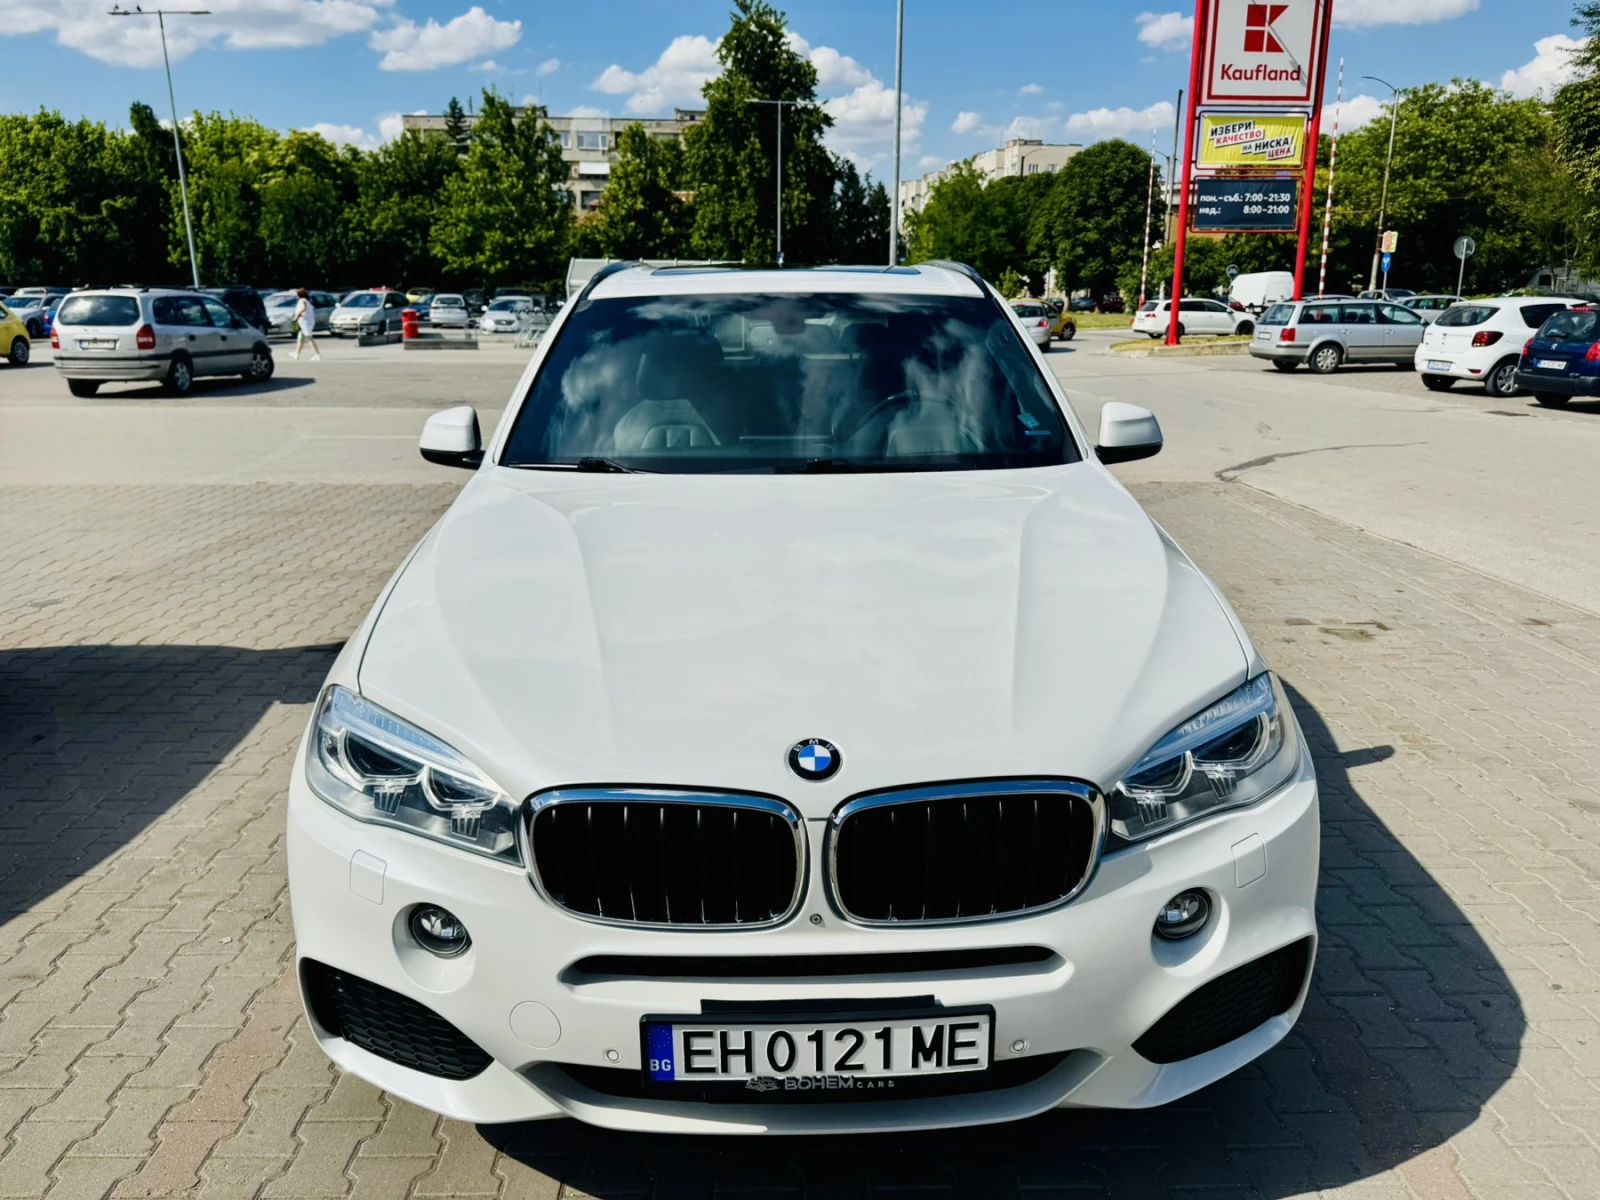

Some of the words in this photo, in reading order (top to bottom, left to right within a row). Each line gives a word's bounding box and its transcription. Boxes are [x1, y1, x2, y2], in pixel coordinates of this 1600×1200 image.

[1221, 64, 1302, 82] Kaufland
[1216, 130, 1262, 145] КАЧЕСТВО
[1254, 137, 1289, 152] НИСКА
[1267, 147, 1292, 158] ЦЕНА
[793, 739, 836, 752] BMW
[683, 1030, 753, 1074] EH
[766, 1027, 892, 1072] 0121
[910, 1022, 980, 1069] ME
[649, 1059, 671, 1072] BG
[785, 1076, 855, 1090] BOHEM
[857, 1081, 895, 1089] CARS
